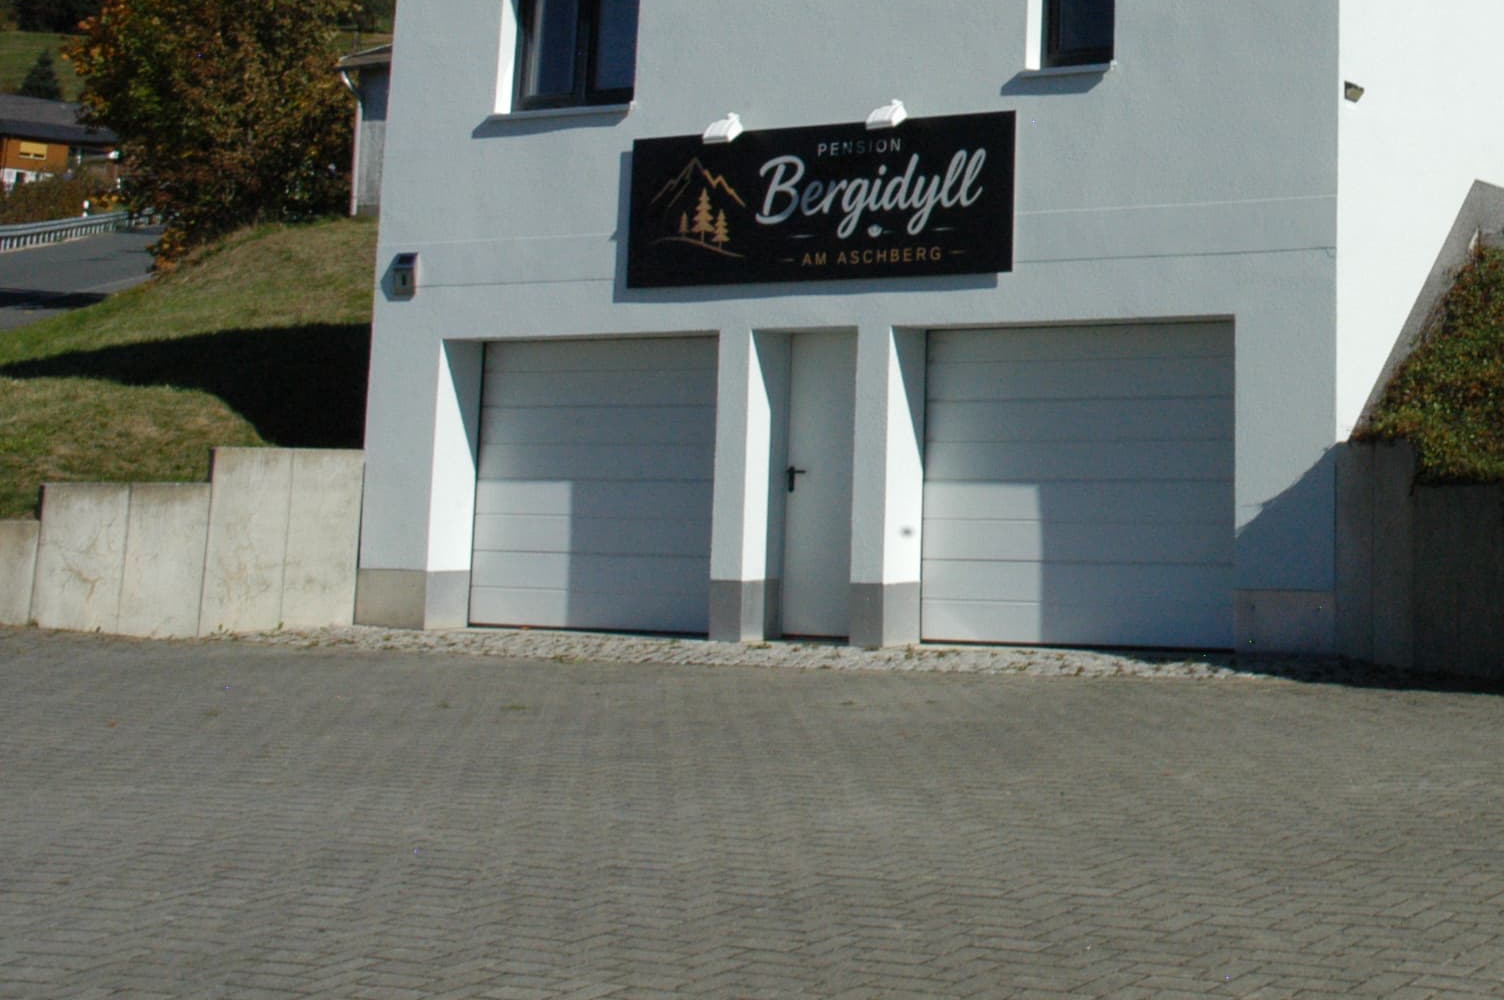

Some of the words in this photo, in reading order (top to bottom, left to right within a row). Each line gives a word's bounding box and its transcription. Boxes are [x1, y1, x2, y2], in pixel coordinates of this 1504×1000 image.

[817, 138, 902, 157] PENSION
[756, 148, 987, 239] Bergidyll
[802, 252, 828, 266] AM
[838, 246, 942, 264] ASCHBERG
